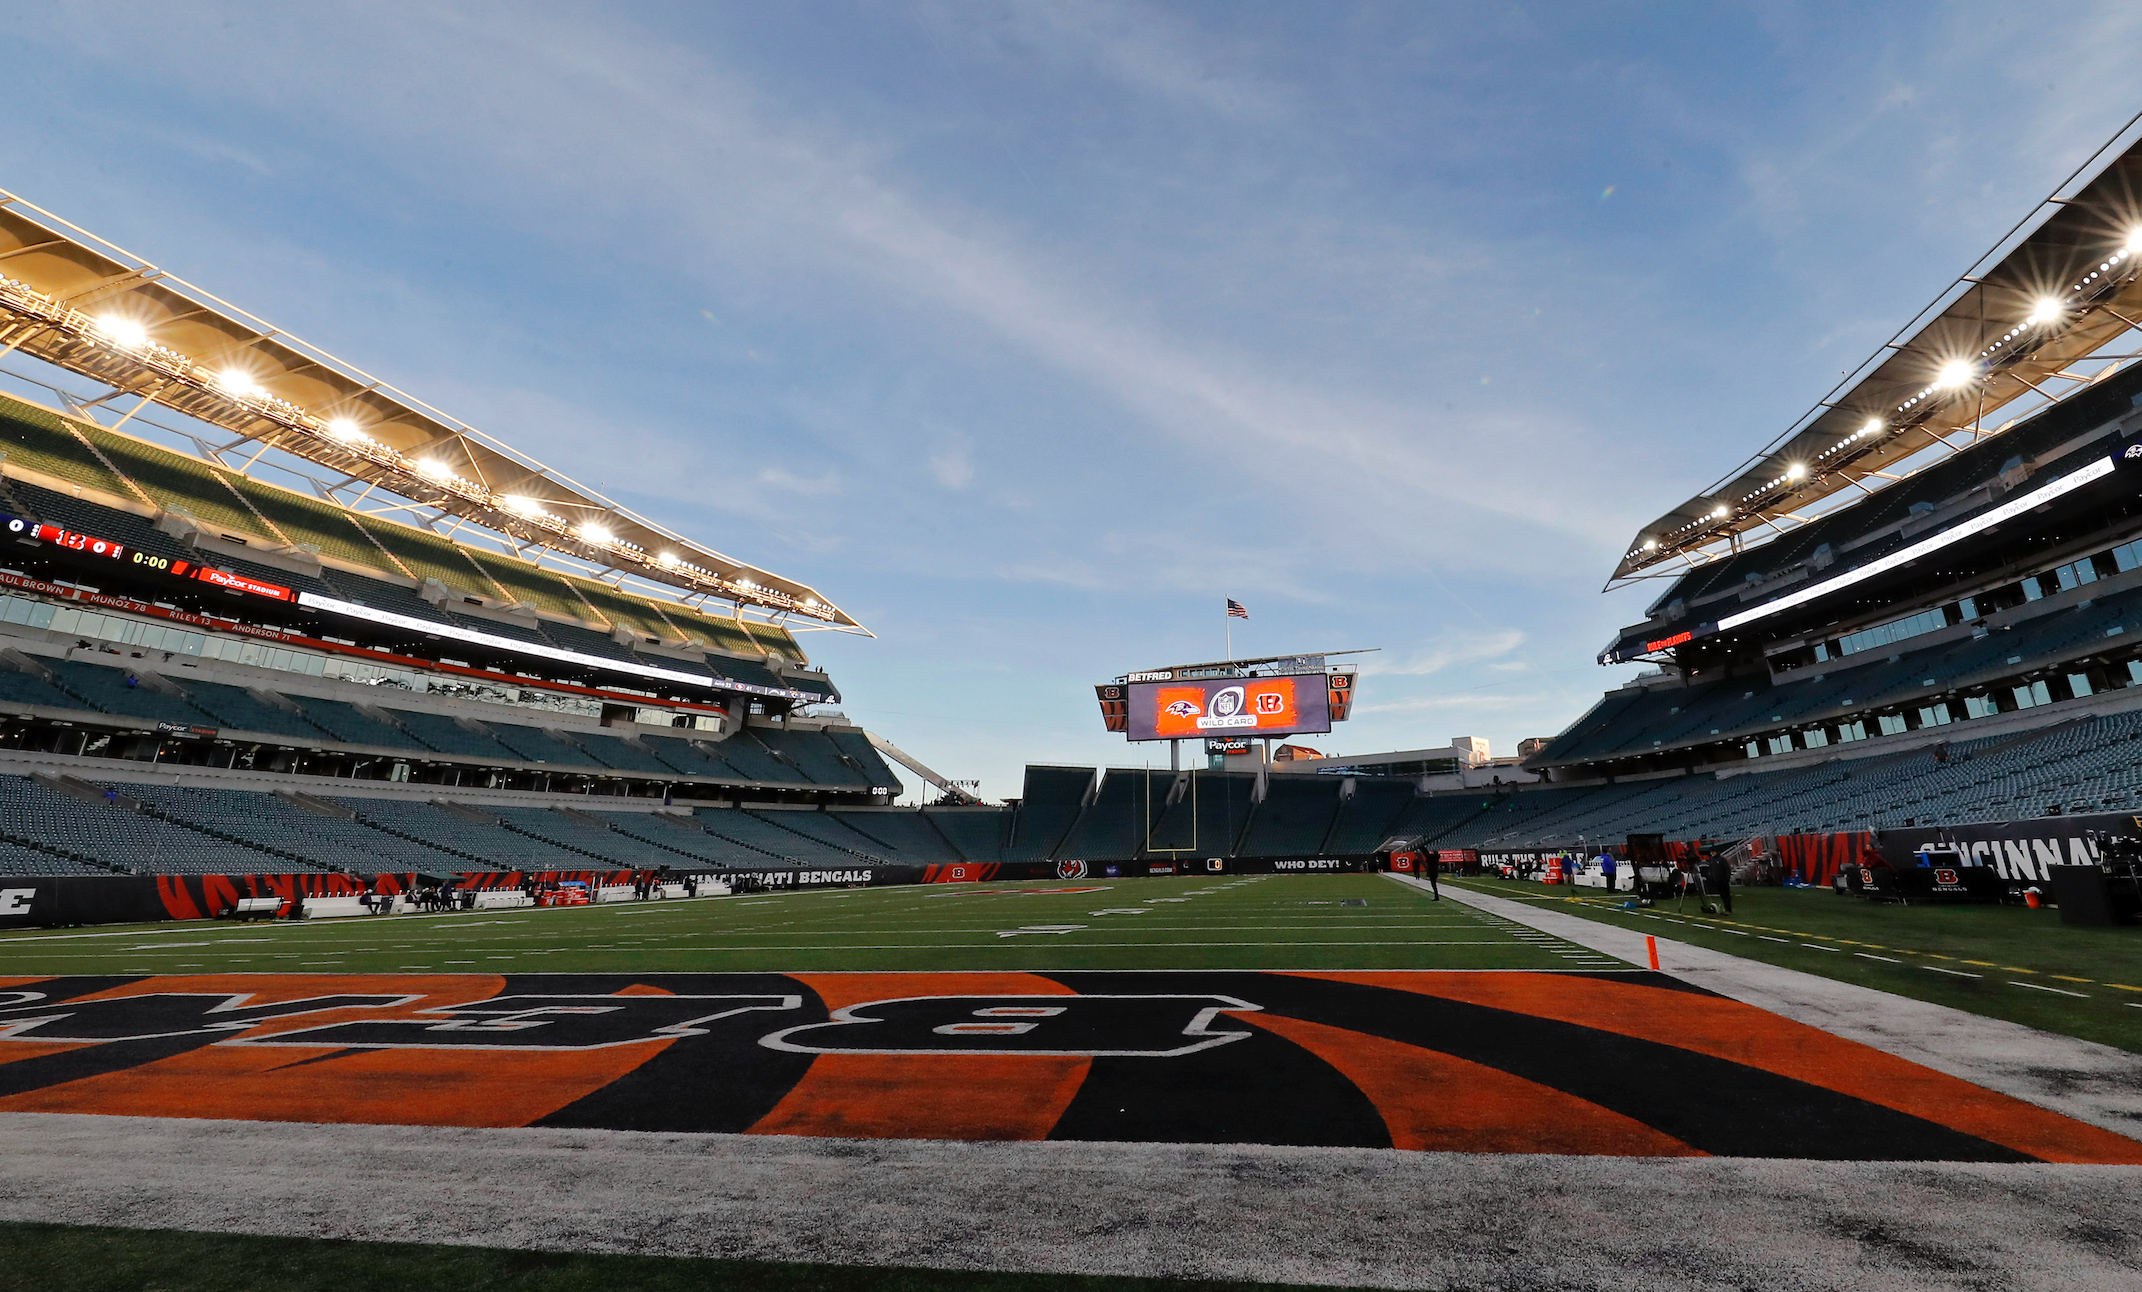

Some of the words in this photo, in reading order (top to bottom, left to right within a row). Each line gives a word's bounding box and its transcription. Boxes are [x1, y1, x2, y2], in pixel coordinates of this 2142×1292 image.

[1970, 516, 1994, 530] Paycor
[2002, 501, 2028, 516] Paycor
[2037, 484, 2064, 500] Paycor
[2072, 467, 2102, 483] Paycor
[132, 552, 168, 570] 0:00
[22, 579, 65, 595] BROWN
[210, 573, 247, 591] Paycor
[247, 583, 280, 596] STADIUM
[90, 594, 130, 609] MUNOZ
[133, 602, 147, 612] 78
[169, 611, 198, 624] RILEY
[201, 617, 211, 626] 13
[308, 597, 336, 608] Paycor
[346, 606, 372, 617] Paycor
[382, 614, 407, 625] Paycor
[232, 624, 279, 639] ANDERSON
[1128, 672, 1172, 682] BETFRED
[159, 722, 187, 732] Paycor
[1227, 718, 1254, 726] CARD
[1209, 740, 1246, 751] Paycor
[1274, 861, 1305, 870] WHO
[1308, 860, 1340, 868] DEY!
[799, 870, 872, 884] BENGALS
